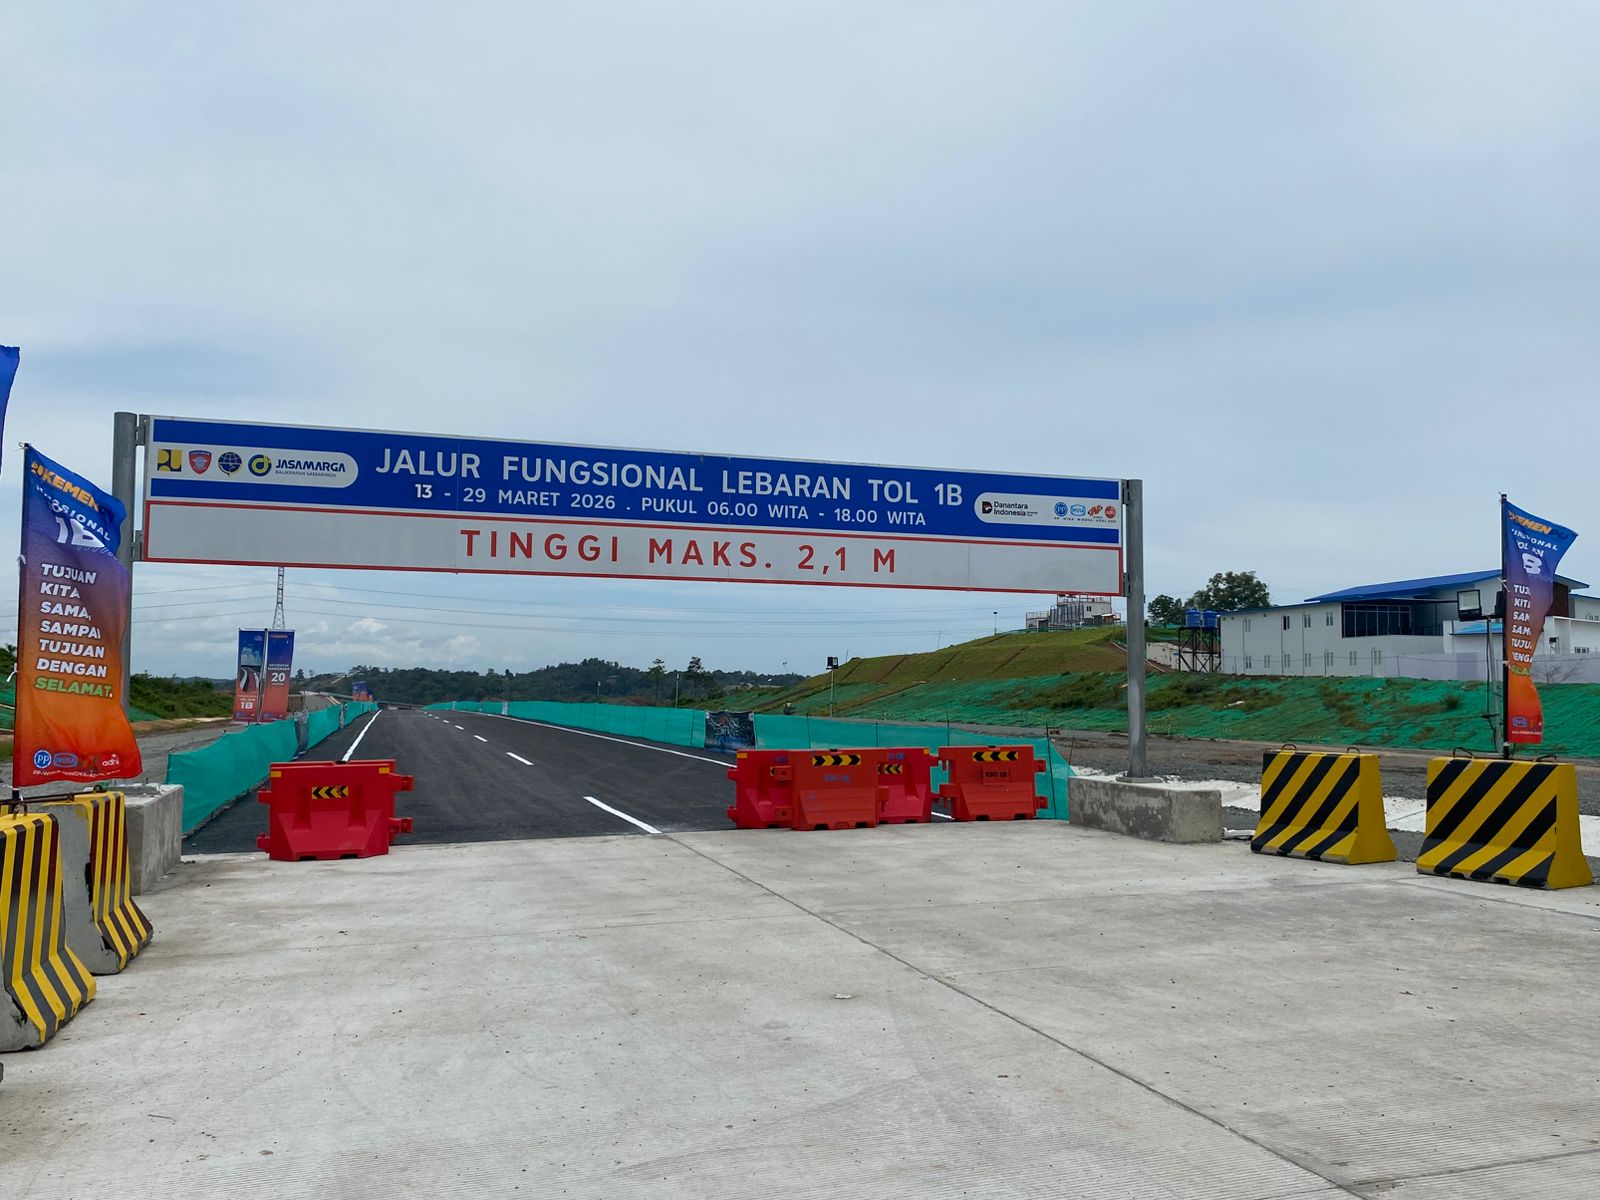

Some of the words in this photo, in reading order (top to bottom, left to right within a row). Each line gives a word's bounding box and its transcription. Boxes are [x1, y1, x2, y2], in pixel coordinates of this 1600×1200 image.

[275, 458, 346, 473] JASAMARGA
[375, 448, 481, 479] JALUR
[502, 455, 704, 492] FUNGSIONAL
[721, 469, 851, 500] LEBARAN
[867, 478, 919, 504] TOL
[934, 483, 963, 506] 1B
[415, 483, 433, 499] 13
[463, 487, 487, 503] 29
[498, 489, 561, 507] MARET
[570, 493, 616, 510] 2026
[641, 497, 698, 514] PUKUL
[707, 501, 758, 518] 06.00
[768, 504, 809, 520] WITA
[834, 508, 878, 524] 18.00
[887, 511, 927, 526] WITA
[993, 501, 1029, 510] Danantara
[993, 508, 1027, 517] Indonesia
[460, 529, 618, 562] TINGGI
[648, 538, 772, 569] MAKS.
[797, 544, 846, 575] 2,1
[873, 548, 895, 573] M
[41, 563, 97, 584] TUJUAN
[40, 582, 81, 599] KITA
[40, 601, 92, 621] SAMA,
[40, 620, 102, 640] SAMPAI
[39, 638, 105, 659] TUJUAN
[36, 658, 107, 678] DENGAN
[271, 672, 286, 683] 20
